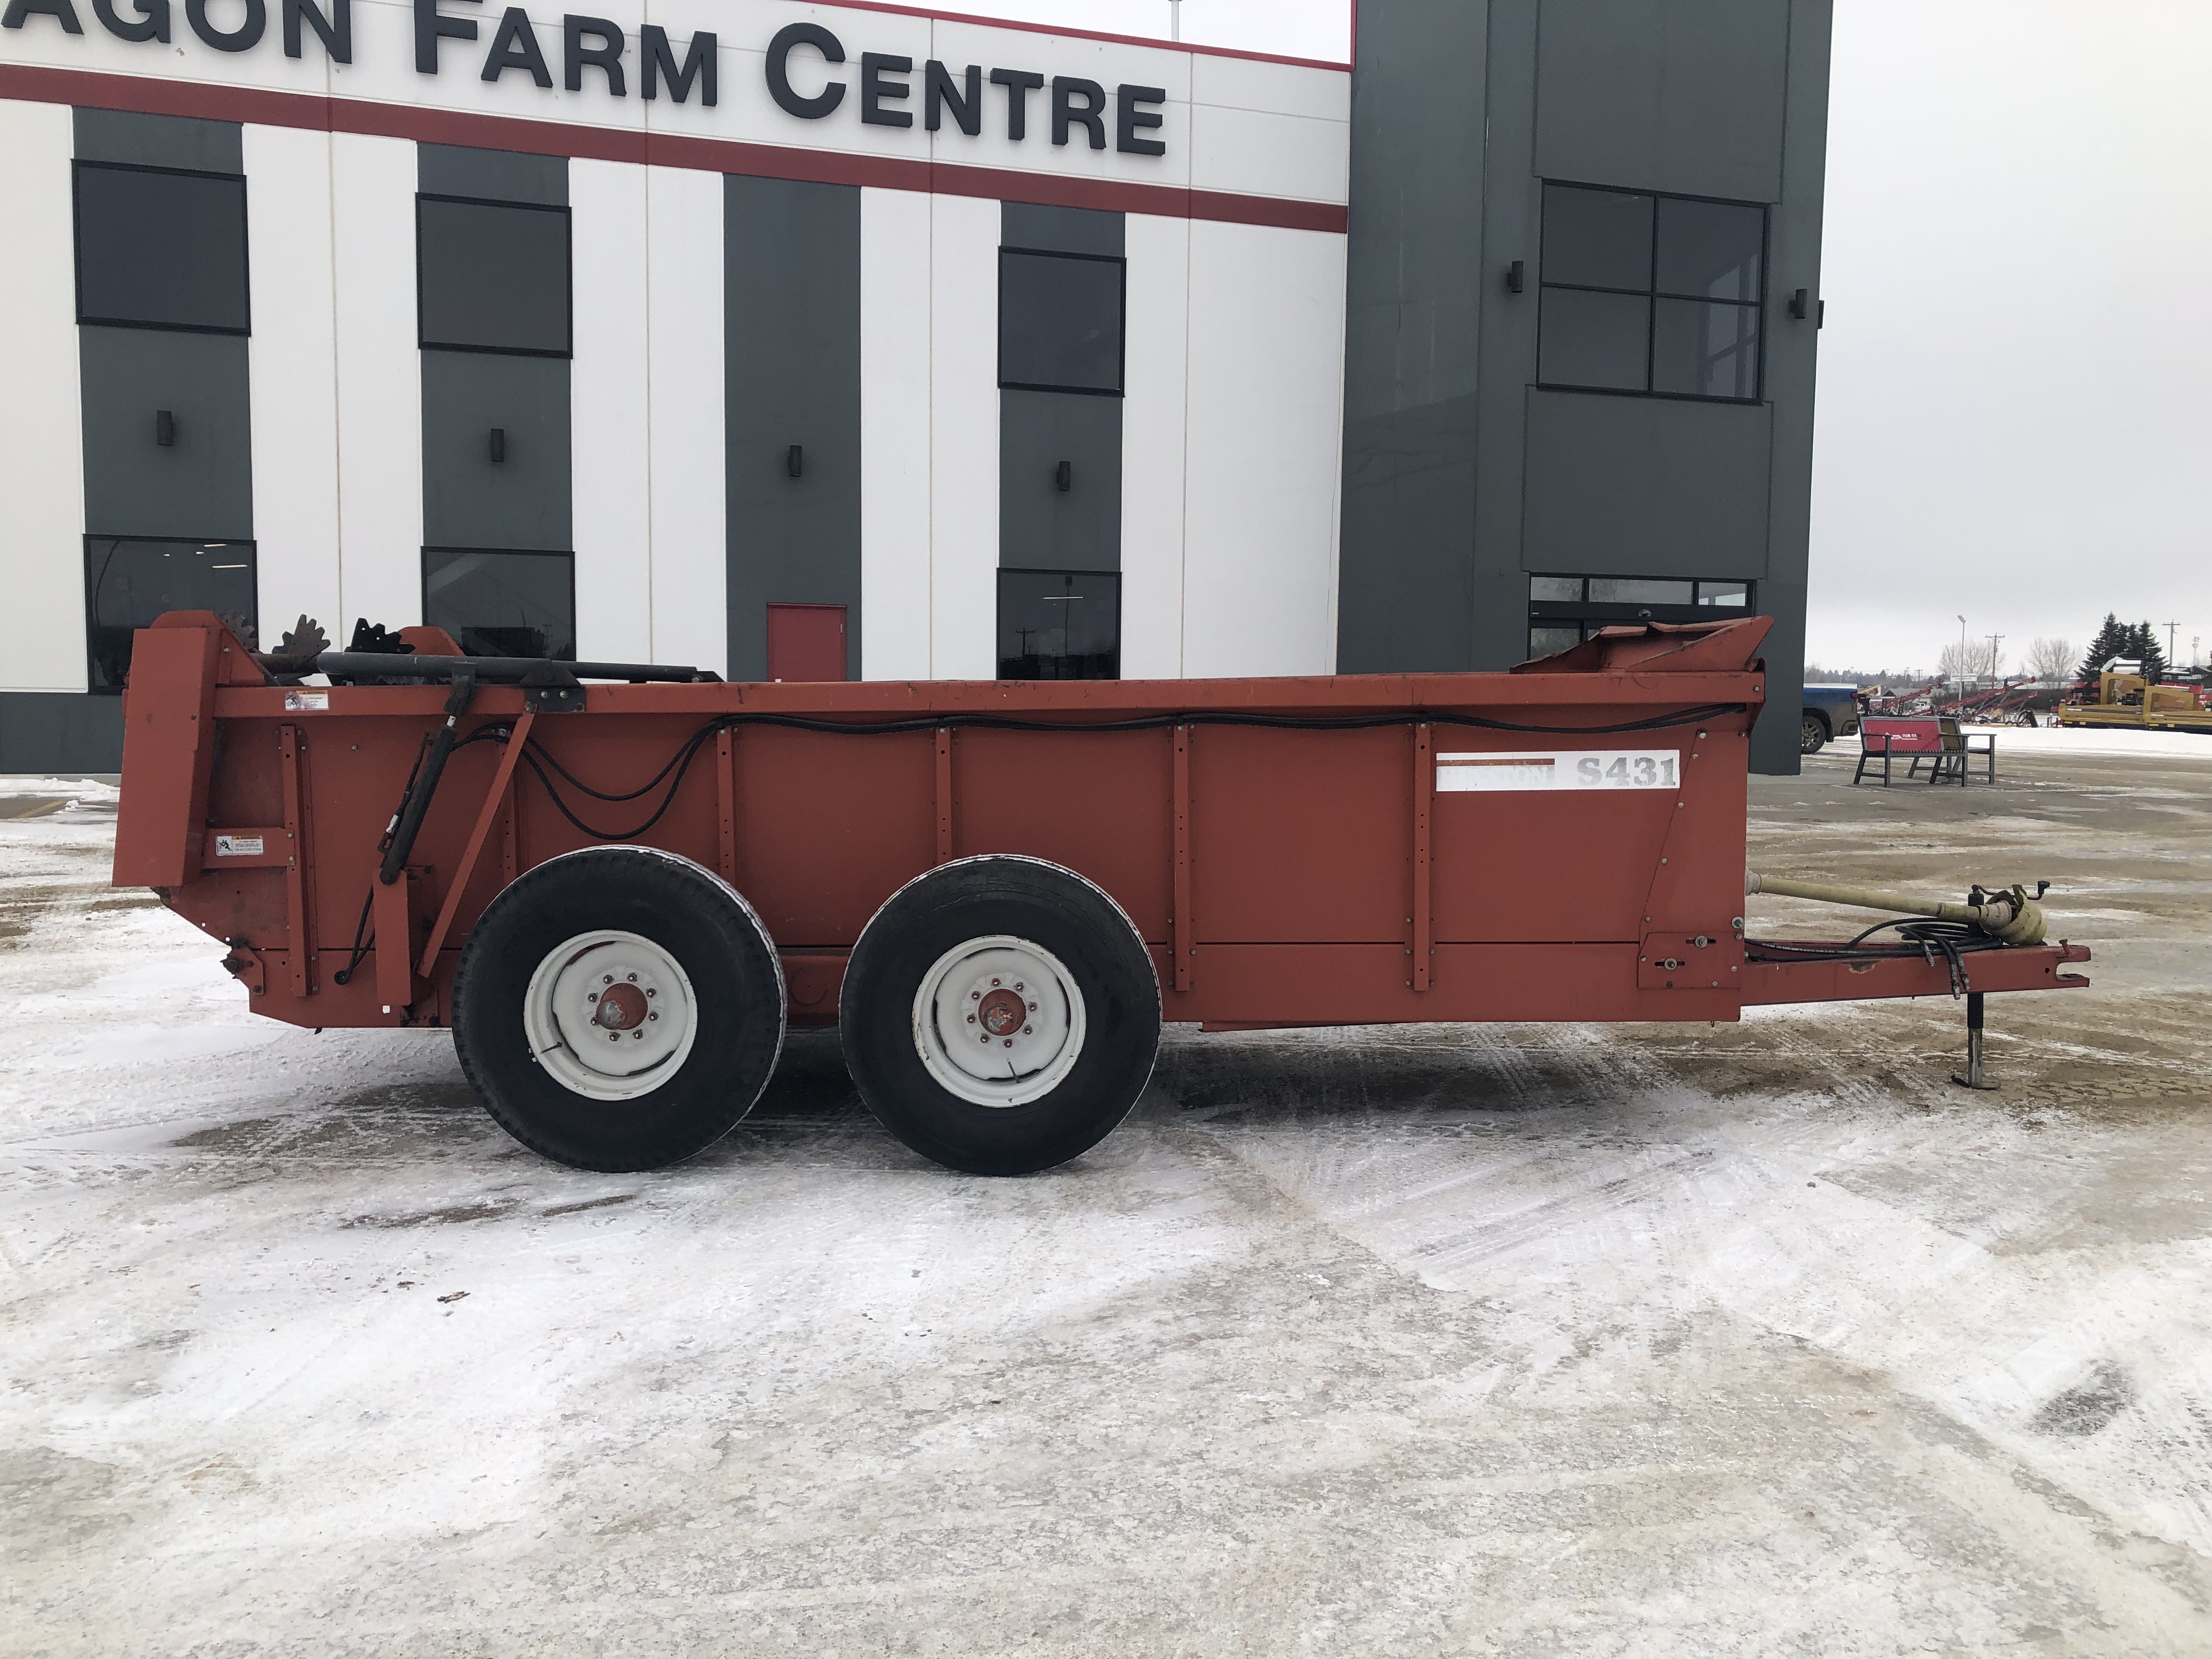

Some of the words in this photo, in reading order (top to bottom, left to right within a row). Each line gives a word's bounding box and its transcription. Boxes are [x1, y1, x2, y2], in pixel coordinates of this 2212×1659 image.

[414, 0, 718, 106] FARM
[765, 22, 1166, 156] CENTRE
[1577, 757, 1676, 787] S431
